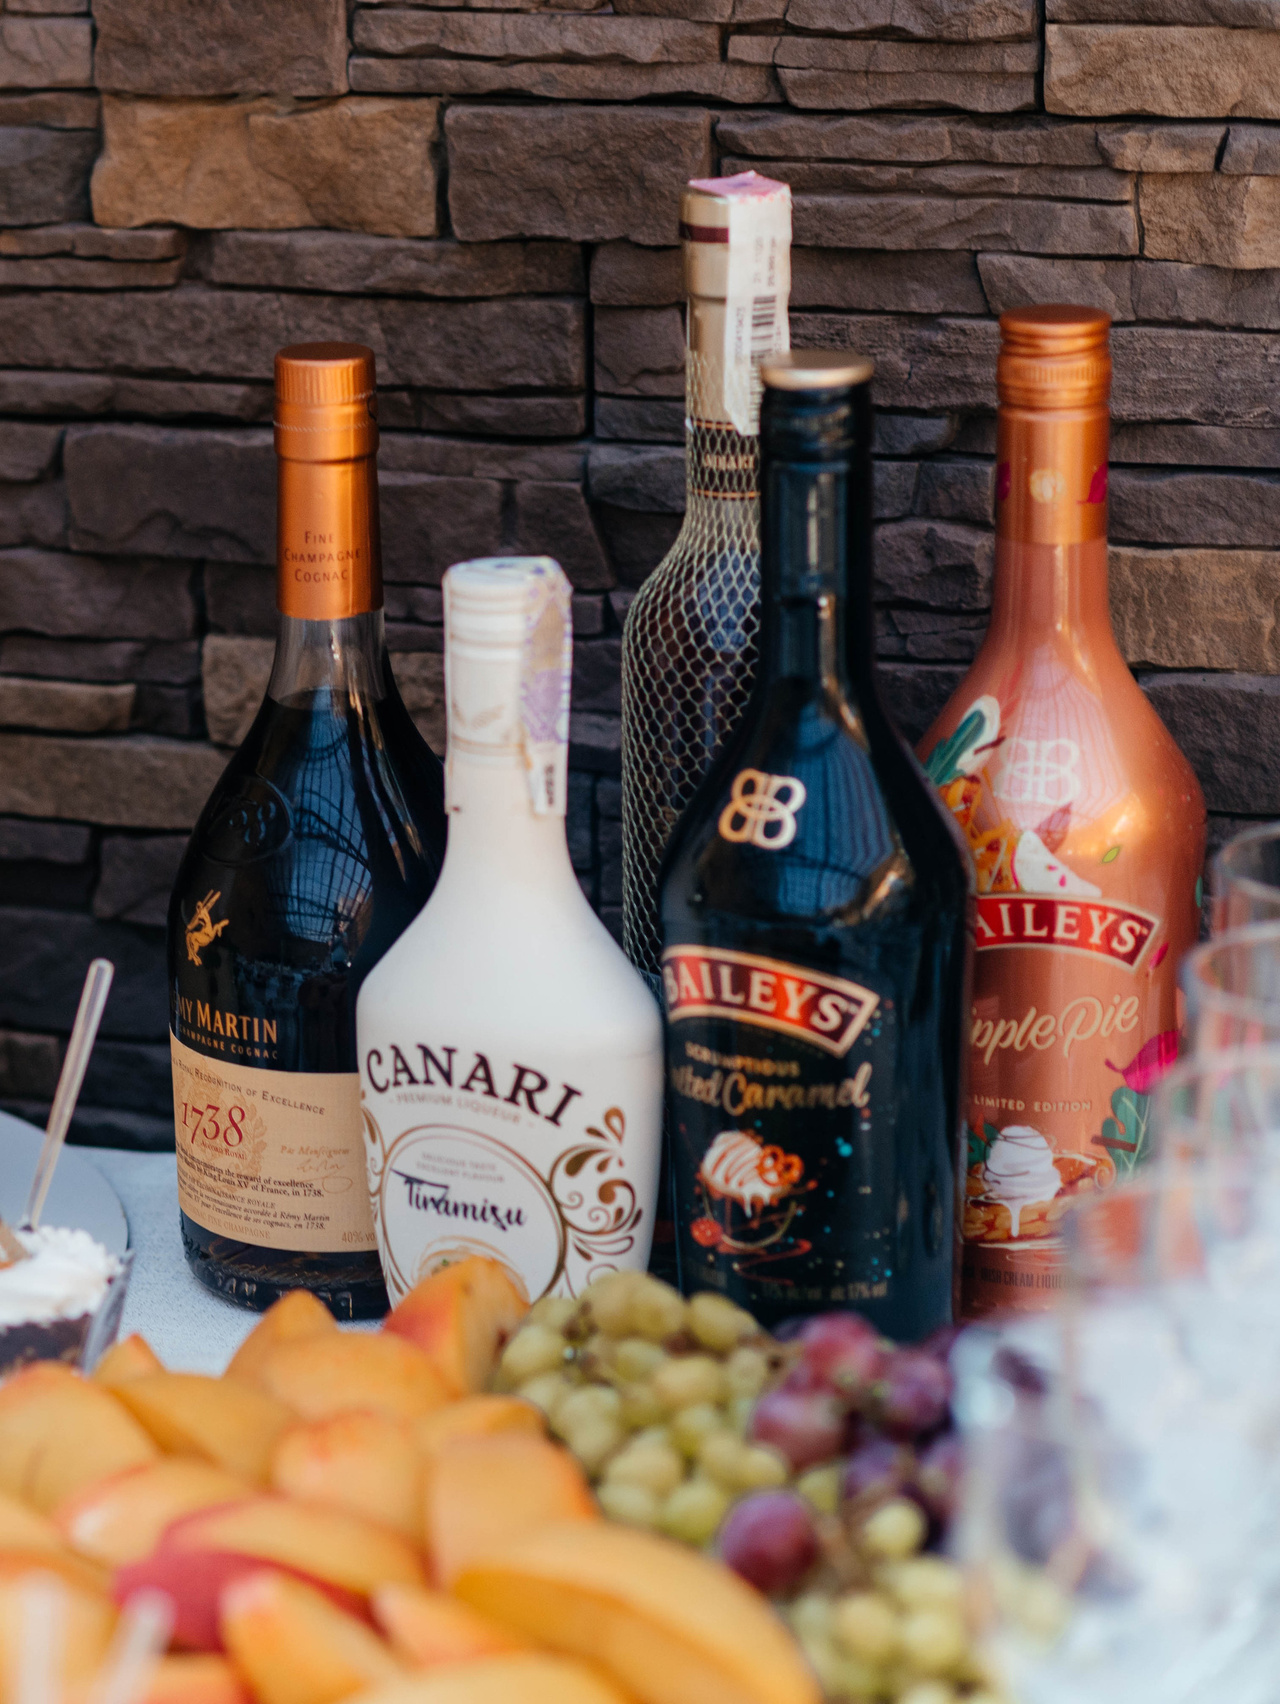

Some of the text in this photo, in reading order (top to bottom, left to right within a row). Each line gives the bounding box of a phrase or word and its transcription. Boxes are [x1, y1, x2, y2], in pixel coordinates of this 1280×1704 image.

[663, 961, 849, 1032] BAILEYS
[196, 999, 278, 1045] MARTIN
[1058, 995, 1140, 1059] Pie
[230, 1043, 278, 1060] COGNAC
[194, 1067, 242, 1094] RECOGNITION
[262, 1090, 326, 1116] EXCELLENCE
[367, 1043, 583, 1127] CANARI
[722, 1061, 873, 1117] Caramel
[456, 1097, 522, 1124] LIQUEUR
[975, 1094, 1092, 1113] LIMITED EDITION
[181, 1102, 246, 1148] 1738
[225, 1168, 235, 1178] the
[236, 1172, 261, 1184] reward
[263, 1176, 272, 1185] of
[273, 1178, 314, 1189] excellence
[251, 1183, 261, 1192] of
[261, 1184, 291, 1197] France,
[303, 1189, 324, 1198] 1738.
[389, 1168, 525, 1231] Tiramisu
[303, 1212, 330, 1222] Martin
[306, 1221, 326, 1230] 1738.
[341, 1231, 363, 1244] 40%
[1003, 1270, 1034, 1288] CREAM
